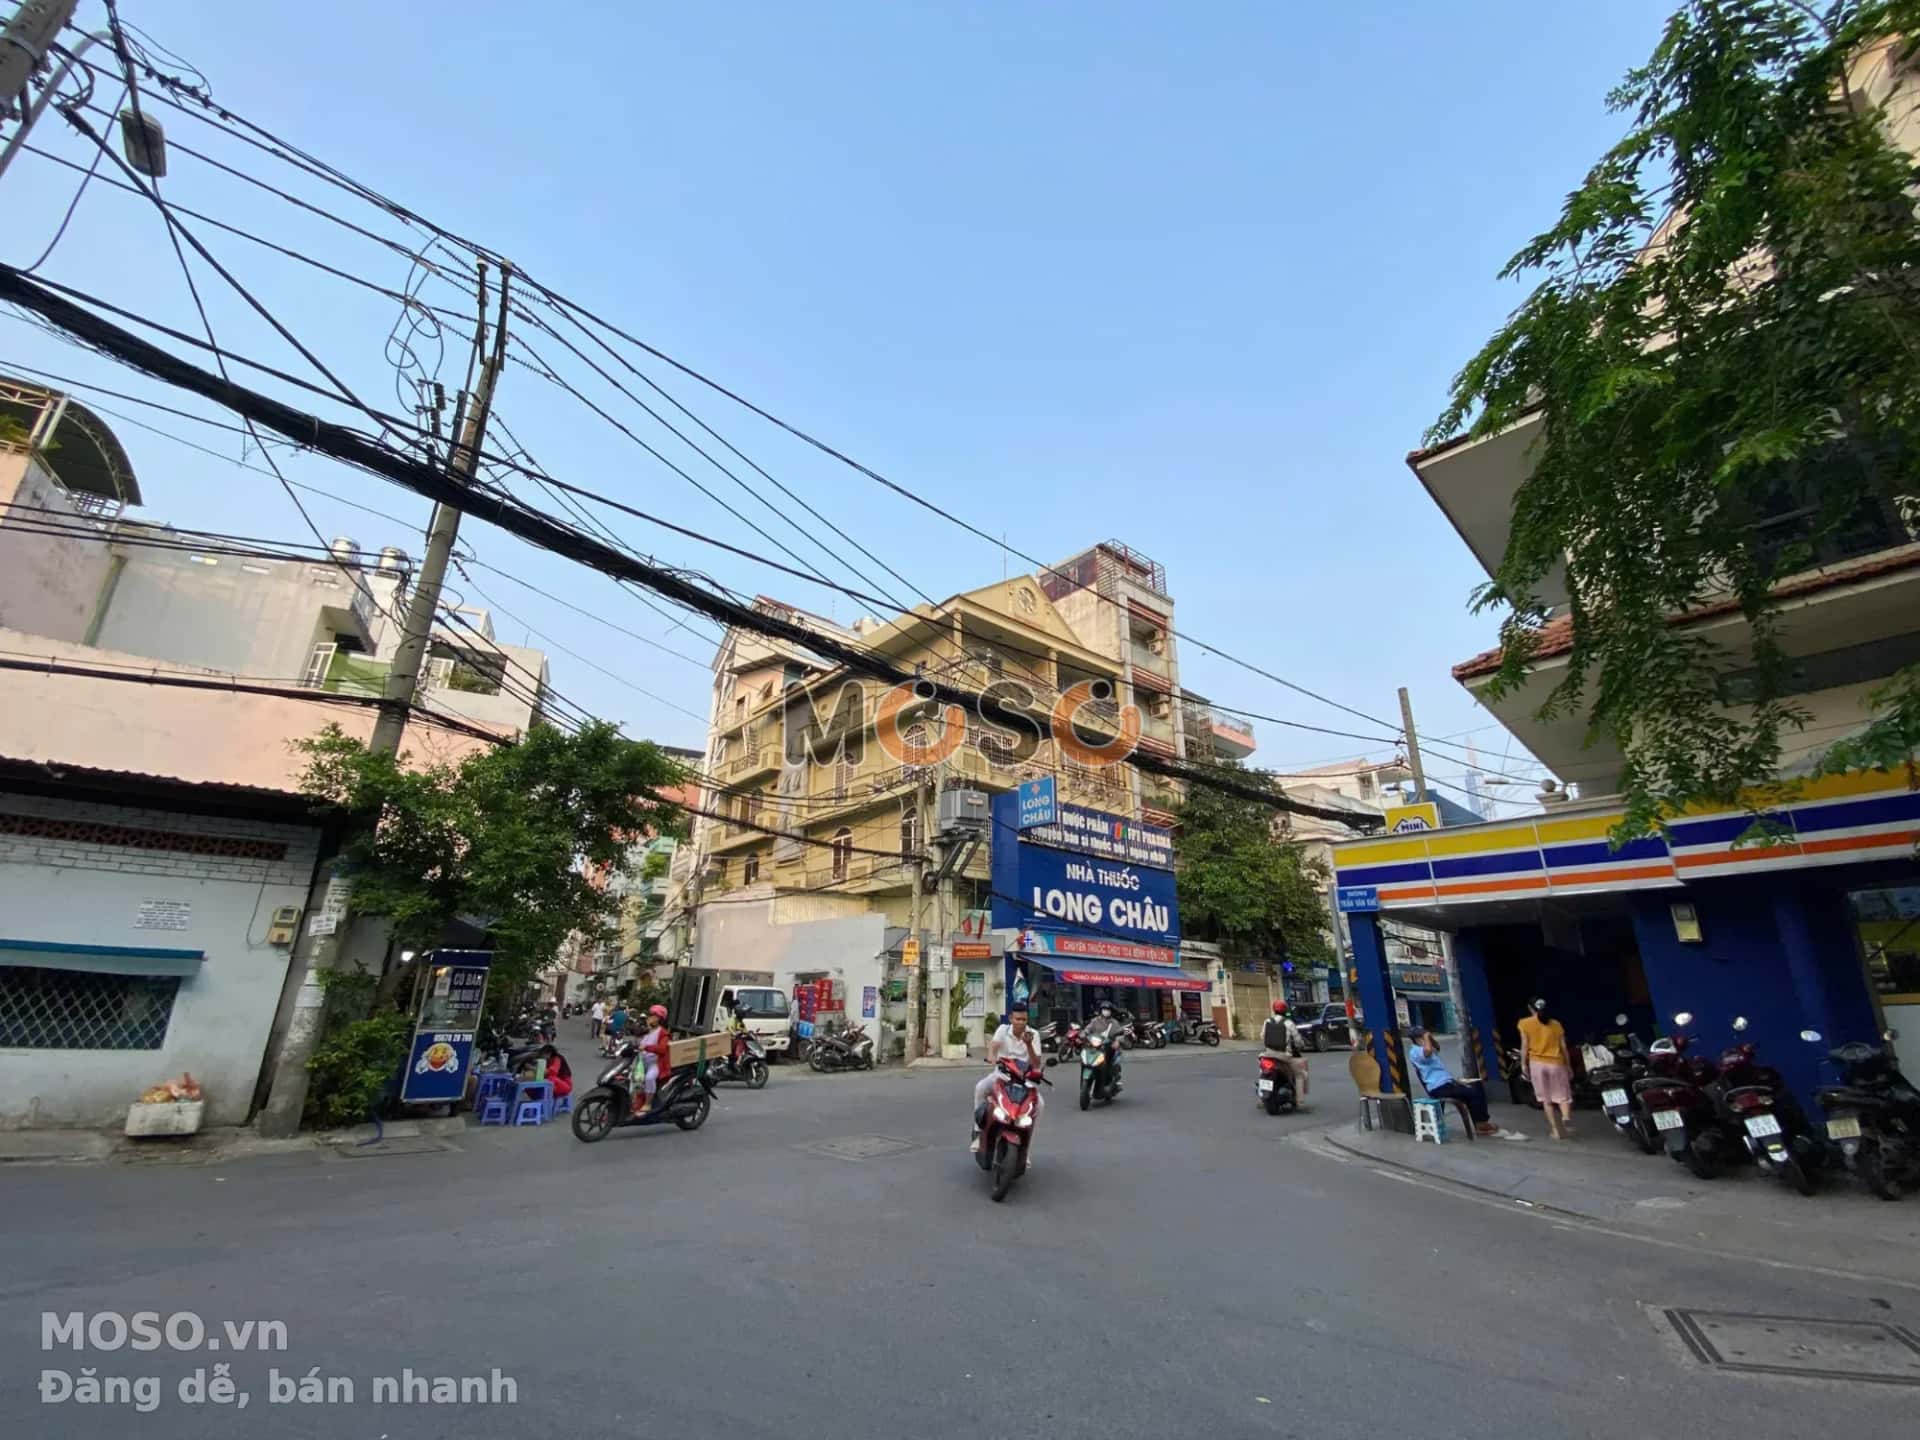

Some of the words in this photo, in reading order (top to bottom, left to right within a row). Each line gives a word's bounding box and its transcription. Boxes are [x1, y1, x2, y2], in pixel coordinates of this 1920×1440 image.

[1023, 797, 1050, 810] LONG
[1401, 822, 1423, 832] MINI
[1066, 860, 1095, 885] NHÀ
[1096, 867, 1140, 891] THUỐC
[1033, 887, 1103, 924] LONG
[1109, 896, 1169, 932] CHÂU
